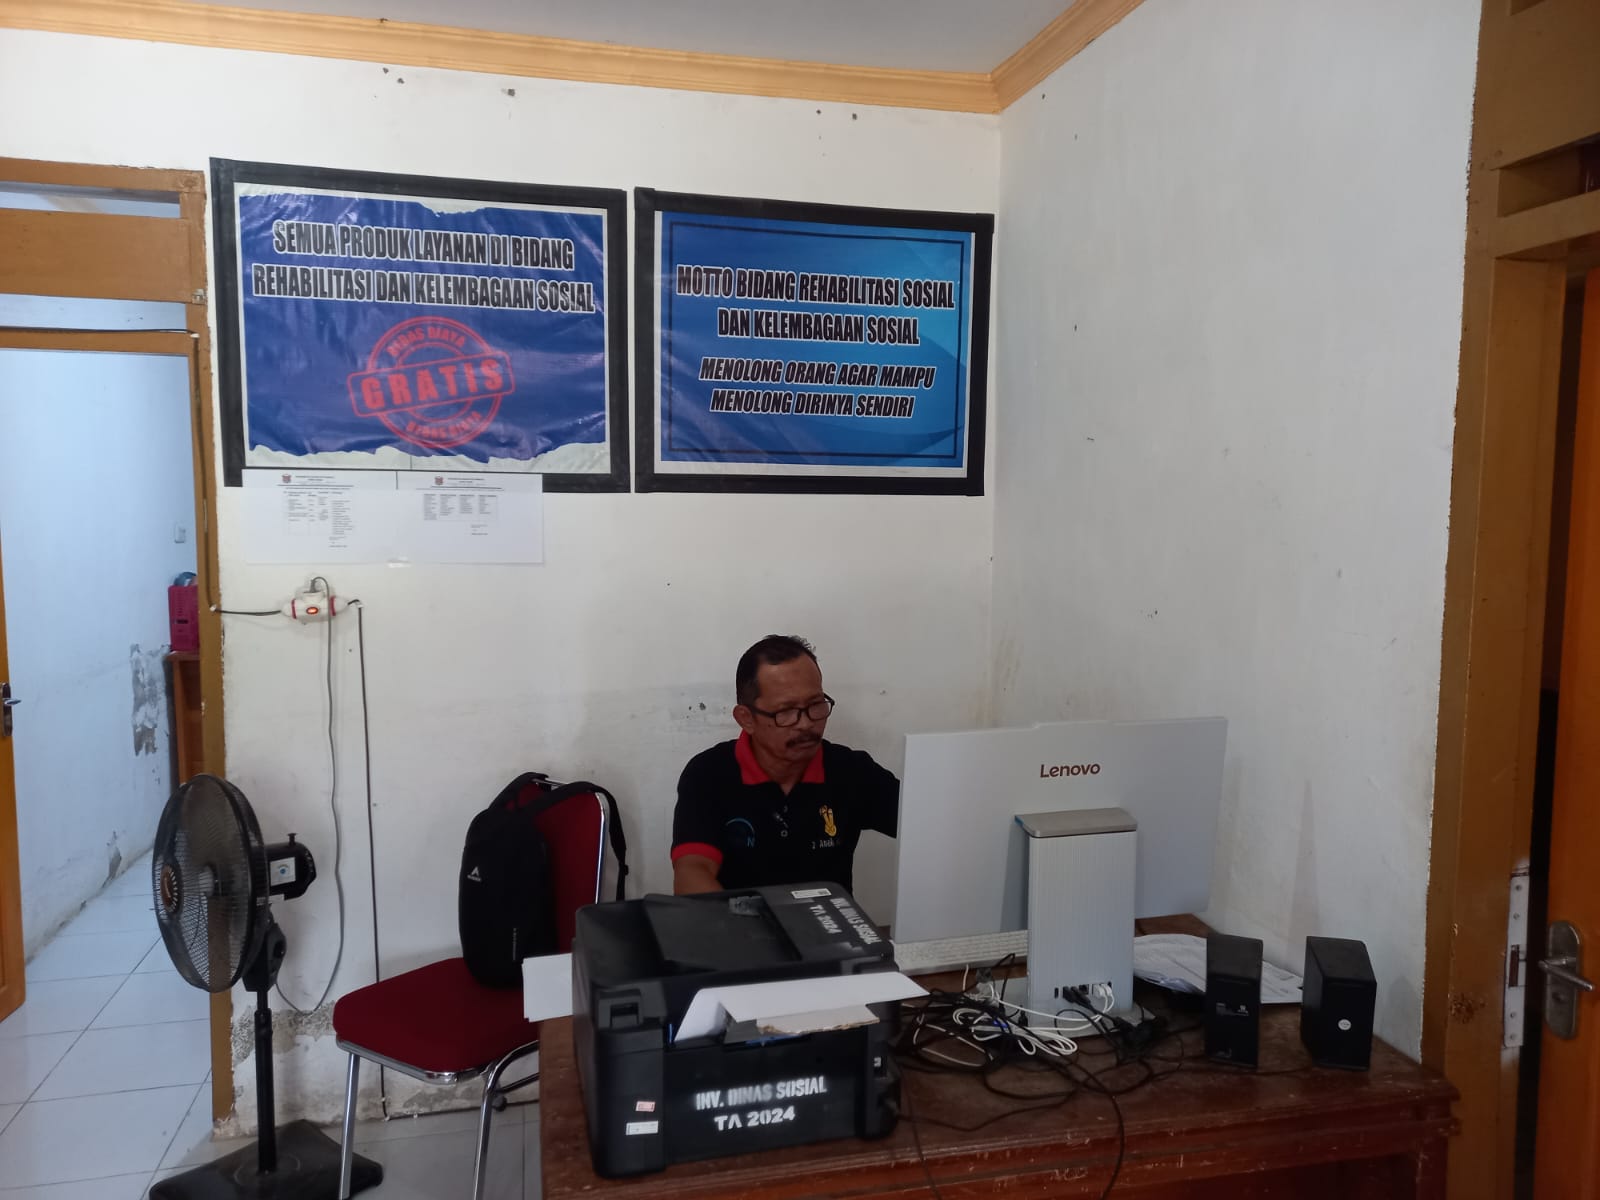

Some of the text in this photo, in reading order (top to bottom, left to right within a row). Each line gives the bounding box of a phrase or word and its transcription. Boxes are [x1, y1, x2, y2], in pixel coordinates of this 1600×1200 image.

[273, 221, 575, 271] SEMUA PRODUK LAYANAN DI BIDANG
[252, 264, 596, 313] REHABILITASI DAN KELEMBAGAAN SOSIAL
[676, 264, 956, 309] MOTTO BIDANG REHABILITASI SOSIAL
[717, 307, 920, 346] DAN KELEMBAGAAN SOSIAL
[361, 359, 503, 409] GRATIS
[698, 356, 936, 389] MENOLONG ORANG AGAR MAMPU
[710, 389, 916, 418] MENOLONG DIRINYA SENDIRI
[1040, 763, 1101, 778] Lenovo
[695, 1089, 724, 1111] INV.
[727, 1084, 773, 1106] DINAS
[713, 1105, 796, 1131] TA 2024
